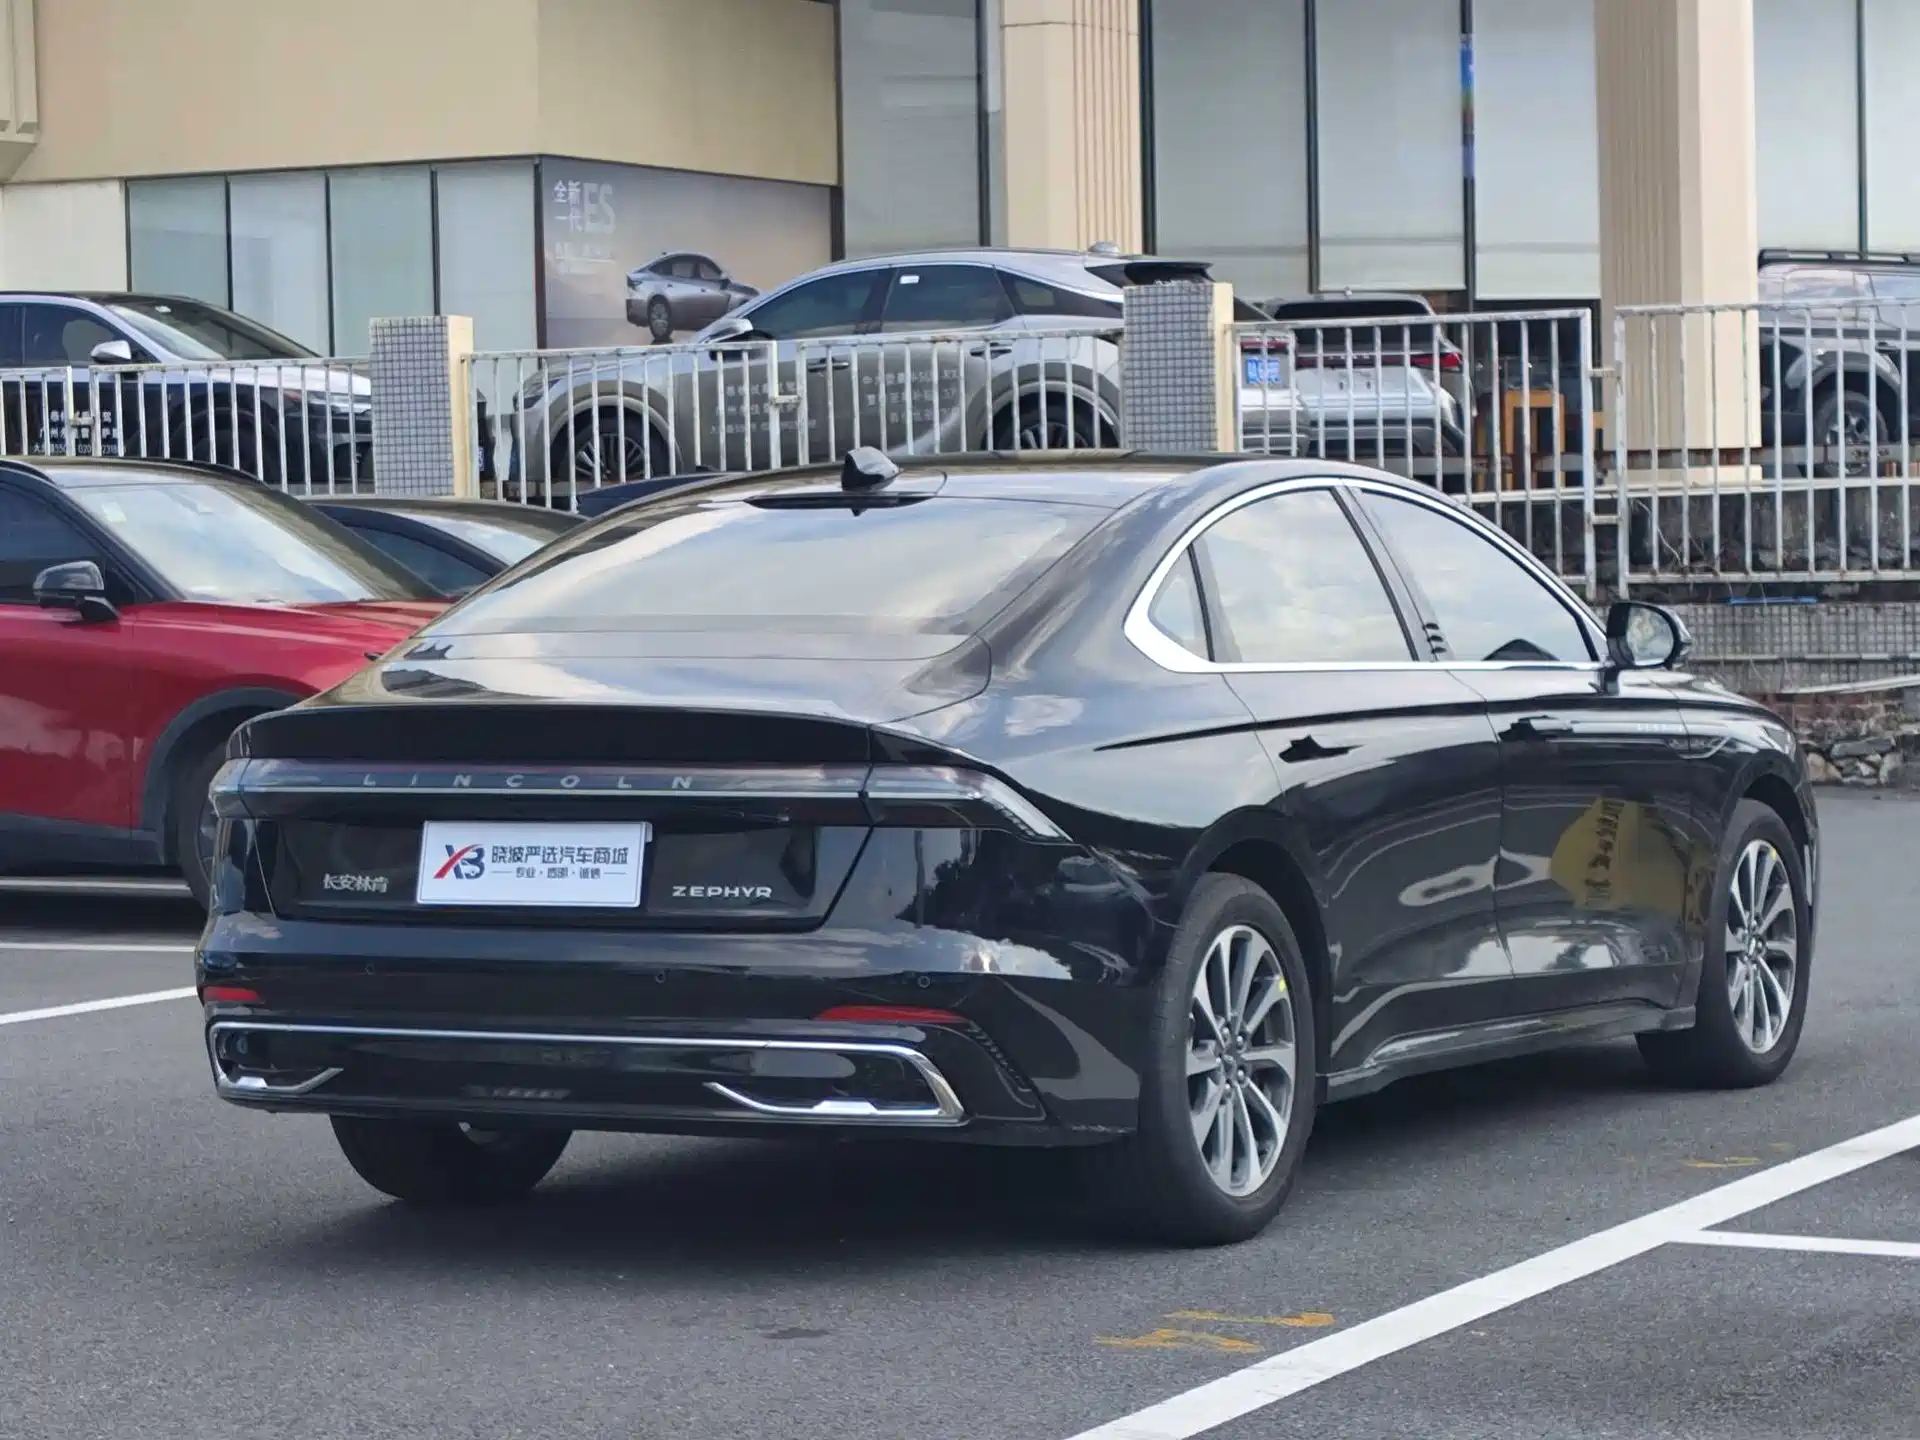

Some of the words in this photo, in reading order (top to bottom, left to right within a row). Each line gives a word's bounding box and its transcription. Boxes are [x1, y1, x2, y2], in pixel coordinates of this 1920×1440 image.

[554, 180, 580, 205] 全新
[583, 182, 616, 235] ES
[363, 773, 693, 789] LINCOLN
[491, 845, 628, 865] 晓波严选汽车商城
[323, 873, 389, 893] 长安林肯
[672, 885, 773, 898] ZEPHYR
